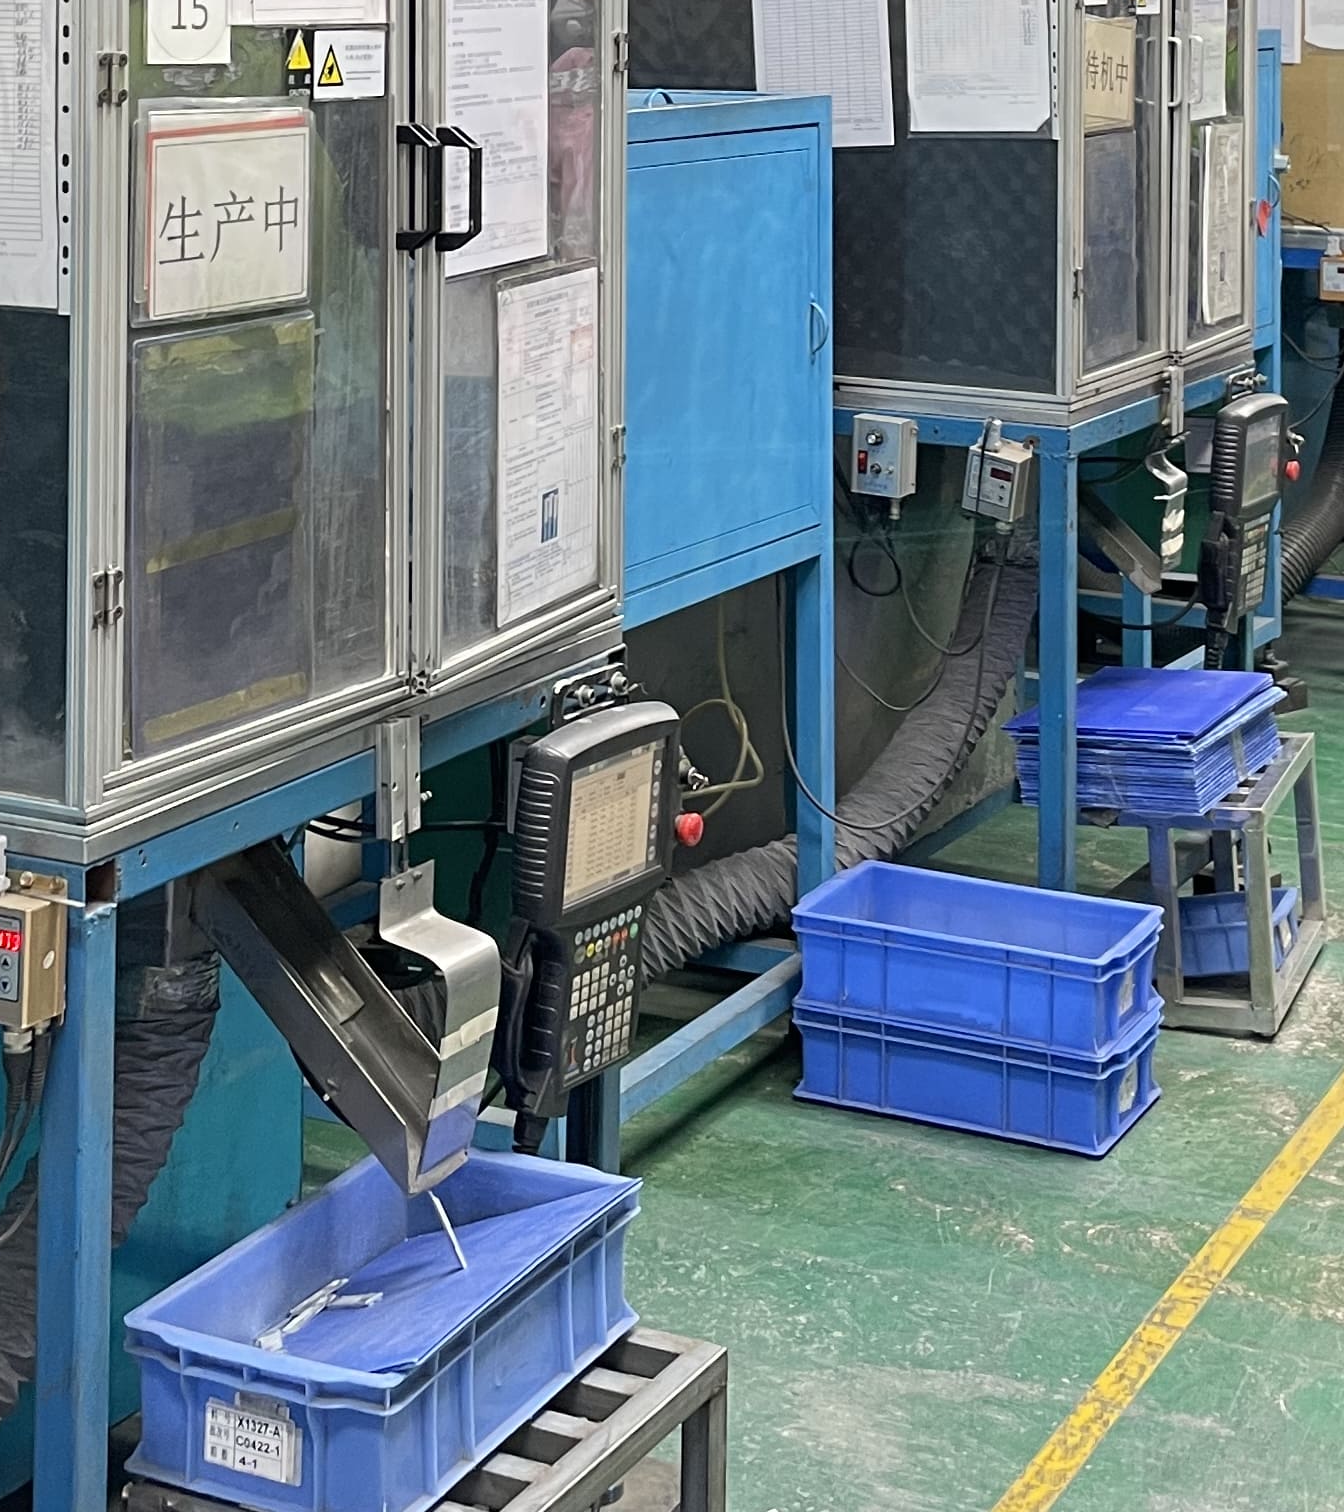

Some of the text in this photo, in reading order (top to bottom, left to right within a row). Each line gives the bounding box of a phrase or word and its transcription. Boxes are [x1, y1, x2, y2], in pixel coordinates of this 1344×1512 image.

[1085, 50, 1129, 94] 待机中
[158, 184, 299, 265] 生产中
[237, 1415, 281, 1438] X1327-A
[236, 1434, 280, 1457] C0422-1
[238, 1455, 258, 1469] 4-1
